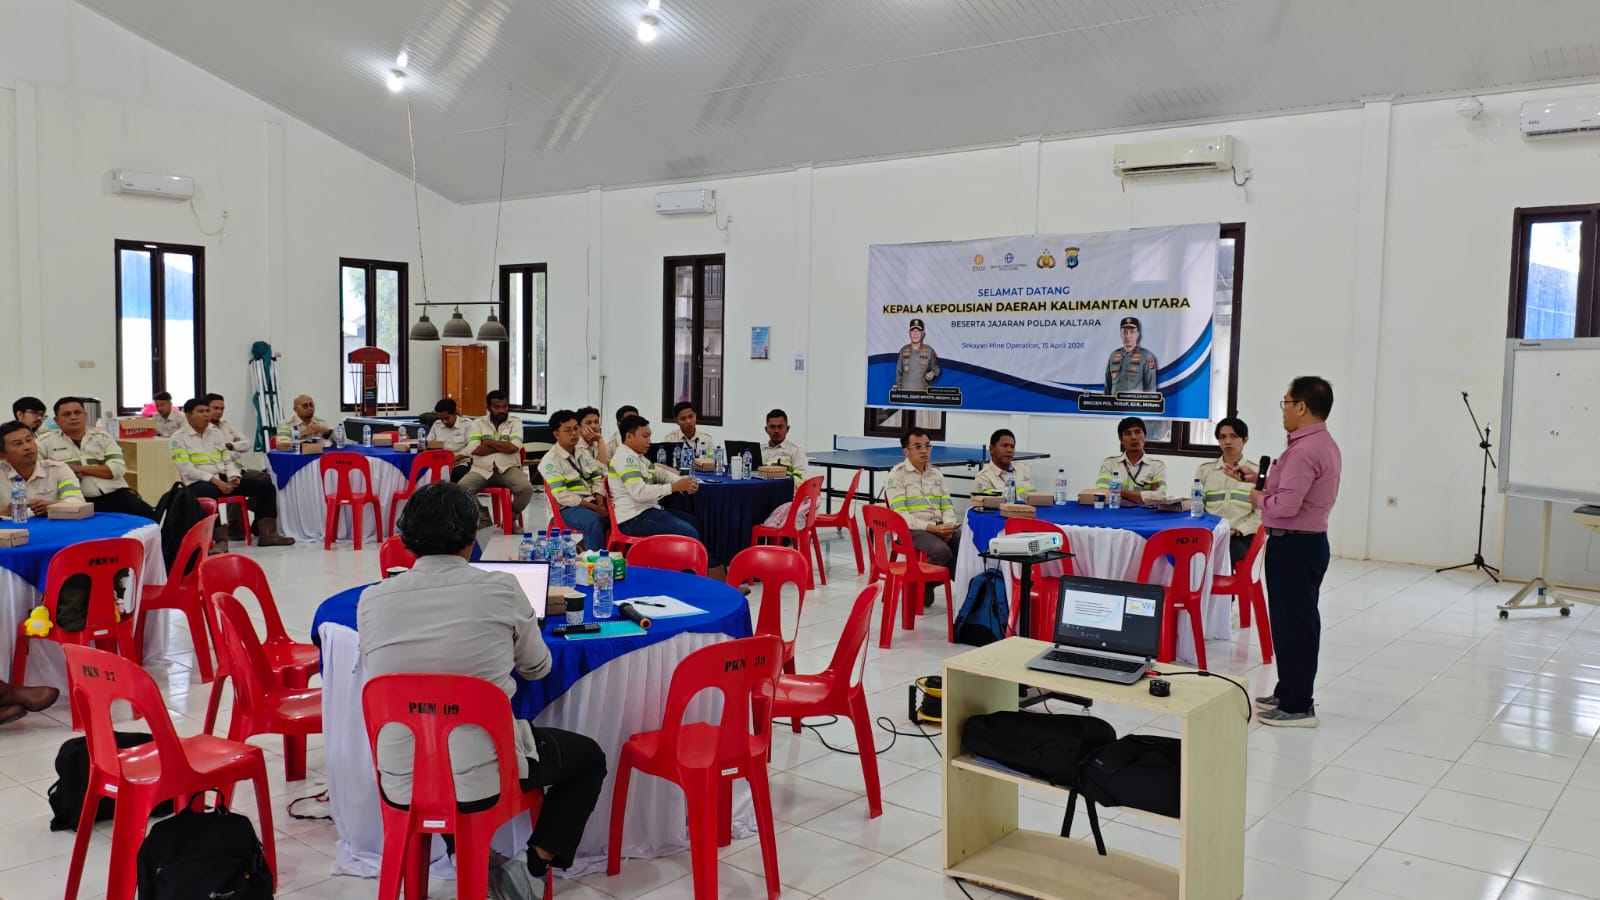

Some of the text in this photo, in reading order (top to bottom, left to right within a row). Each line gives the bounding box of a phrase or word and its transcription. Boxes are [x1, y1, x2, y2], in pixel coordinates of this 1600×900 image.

[978, 286, 1070, 297] SELAMAT DATANG
[883, 297, 1191, 314] KEPALA KEPOLISIAN DAERAH KALIMANTAN UTARA
[951, 318, 1102, 328] BESERTA JAJARAN POLDA KALTARA
[961, 342, 988, 350] Sekayan
[1006, 342, 1040, 350] Operation,
[1050, 342, 1066, 350] April
[82, 664, 99, 678] PKN
[723, 658, 746, 672] PKN
[409, 701, 460, 716] PKN 09
